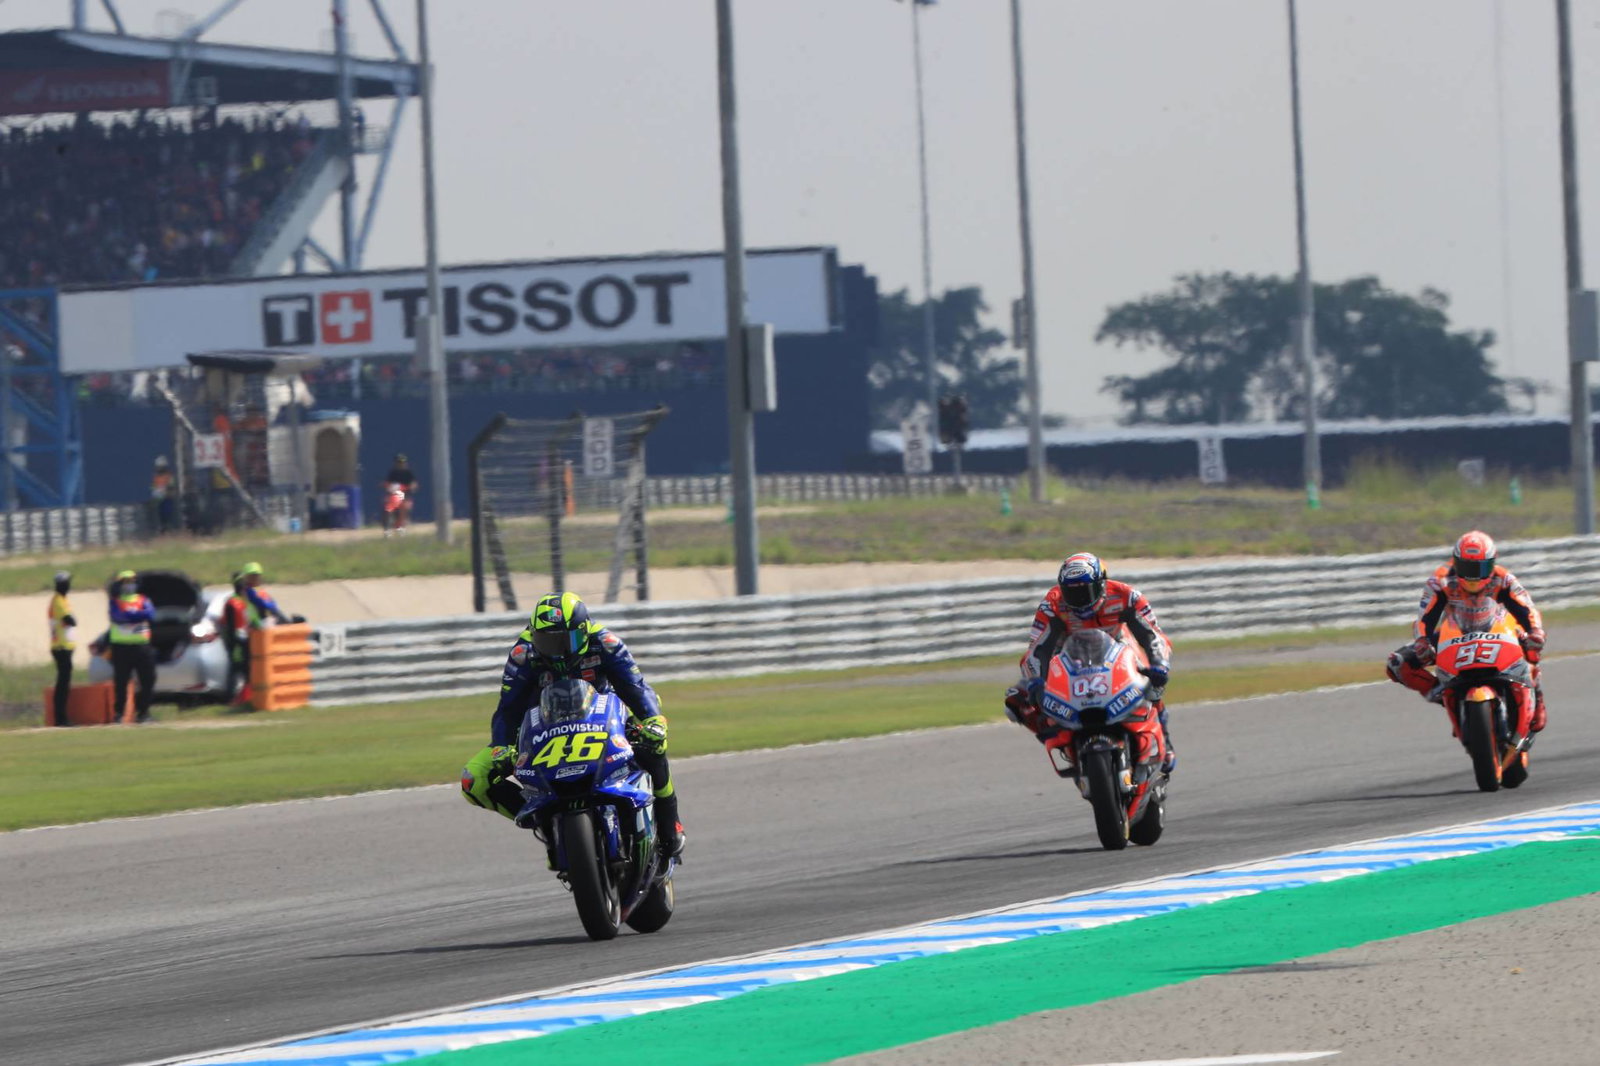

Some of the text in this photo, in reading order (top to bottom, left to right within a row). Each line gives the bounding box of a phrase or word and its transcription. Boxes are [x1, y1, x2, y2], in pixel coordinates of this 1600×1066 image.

[382, 272, 691, 339] TISSOT
[1454, 643, 1502, 669] 93
[1073, 674, 1109, 698] 04
[549, 723, 605, 736] movistar
[531, 732, 608, 768] 46
